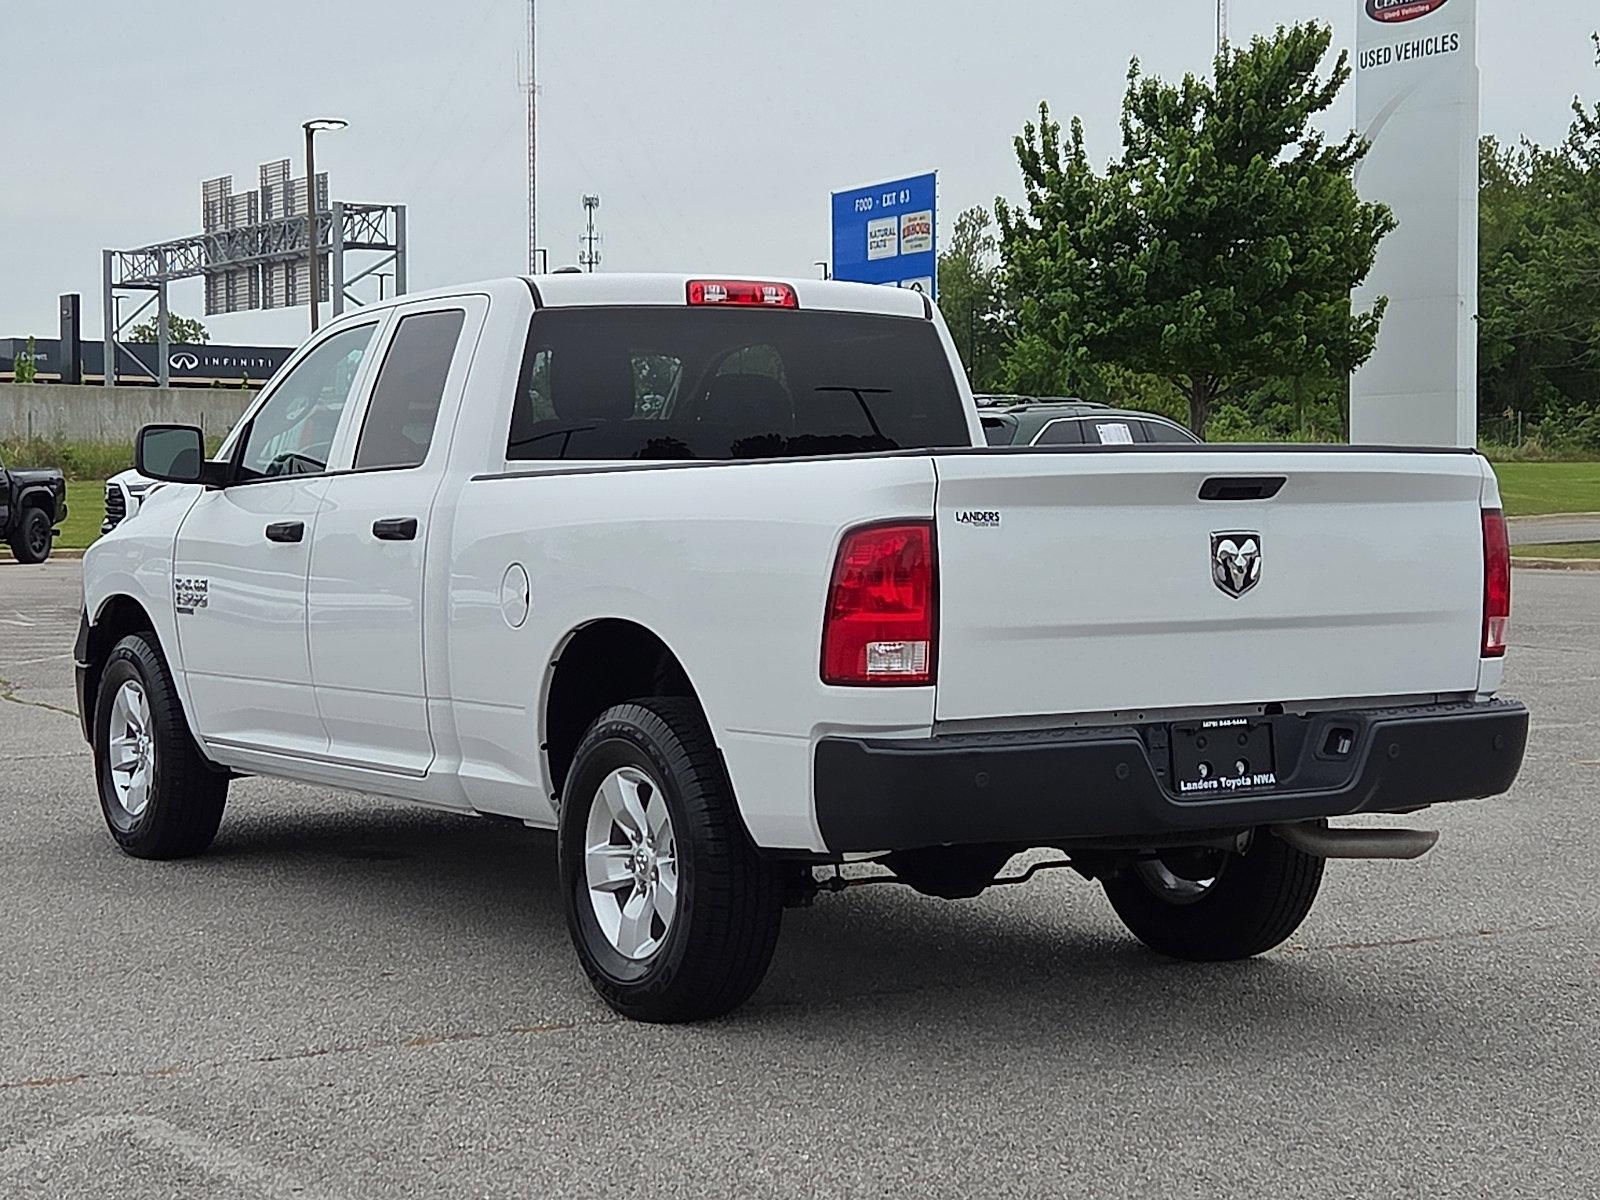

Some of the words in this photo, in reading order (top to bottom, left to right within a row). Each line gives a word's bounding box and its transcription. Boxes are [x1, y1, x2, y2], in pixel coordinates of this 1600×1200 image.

[1360, 46, 1391, 69] USED
[1395, 33, 1459, 62] VEHICLES
[855, 197, 873, 212] FOOD
[882, 192, 897, 207] EXIT
[869, 227, 896, 239] NATURAL
[869, 239, 887, 250] STATE
[204, 357, 272, 368] INFINITI
[955, 511, 1000, 523] LANDERS
[1180, 780, 1218, 791] Landers
[1220, 776, 1251, 790] Toyota
[1253, 773, 1276, 785] NWA
